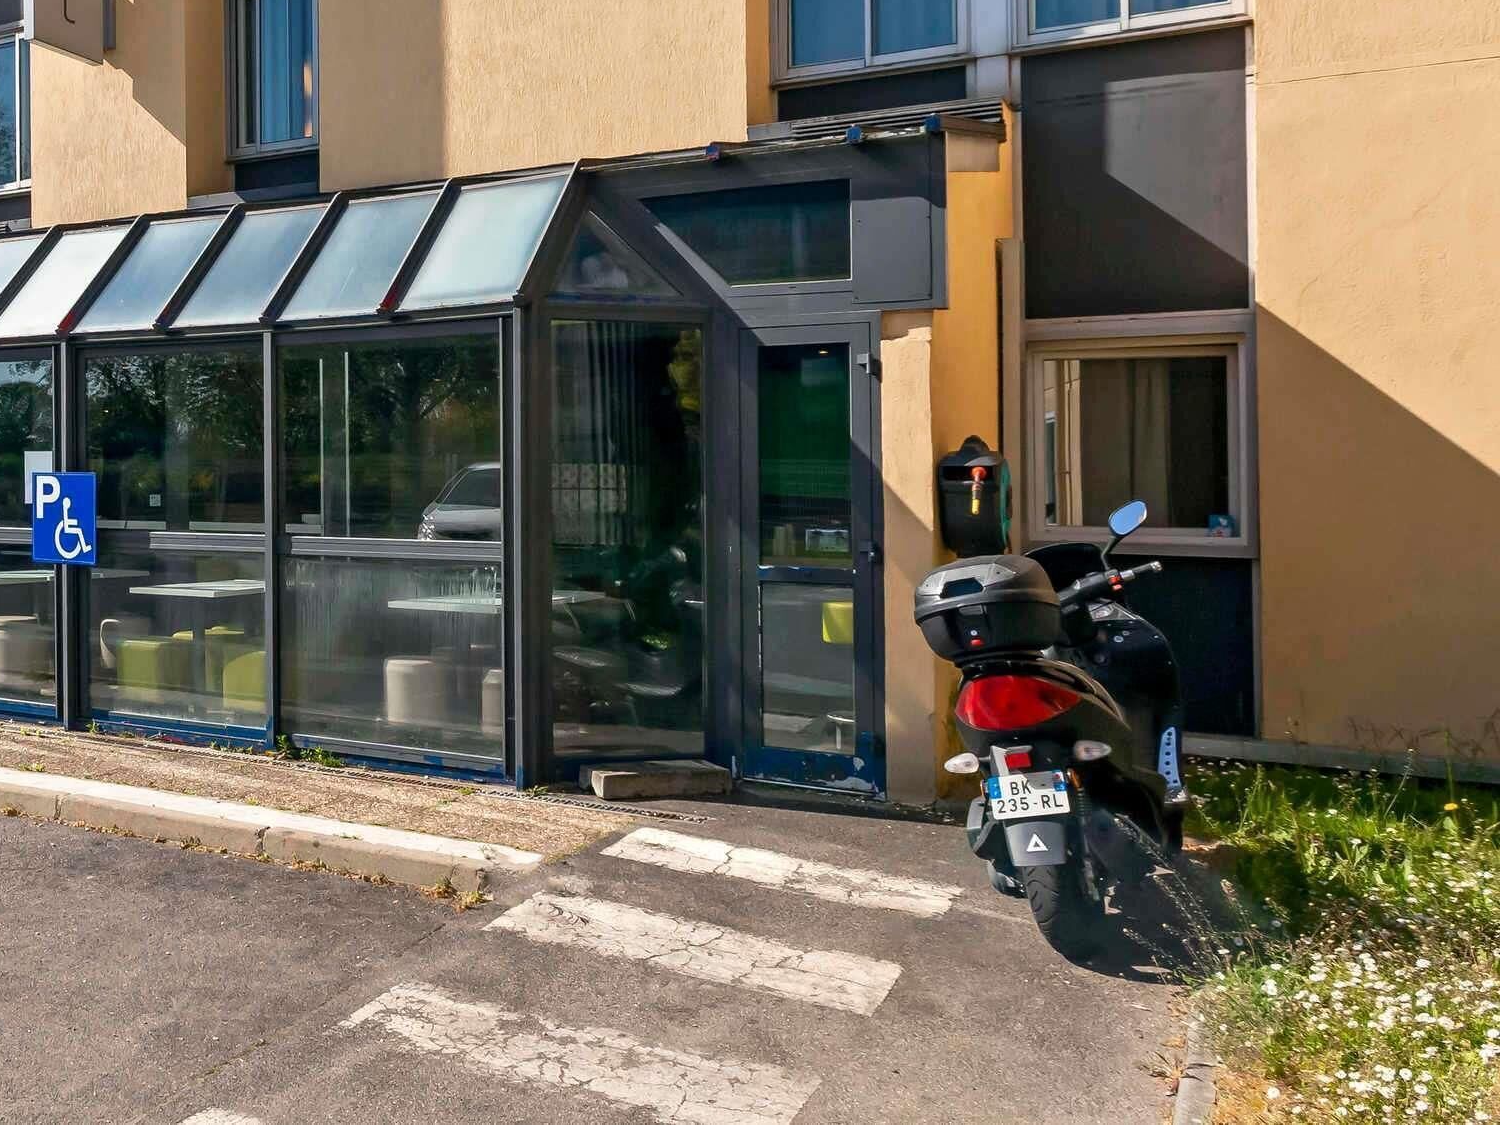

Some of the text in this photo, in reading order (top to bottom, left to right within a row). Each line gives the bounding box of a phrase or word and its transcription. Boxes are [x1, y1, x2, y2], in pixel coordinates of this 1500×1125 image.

[35, 475, 60, 519] P
[1010, 780, 1032, 796] BK
[997, 793, 1064, 814] 235-RL
